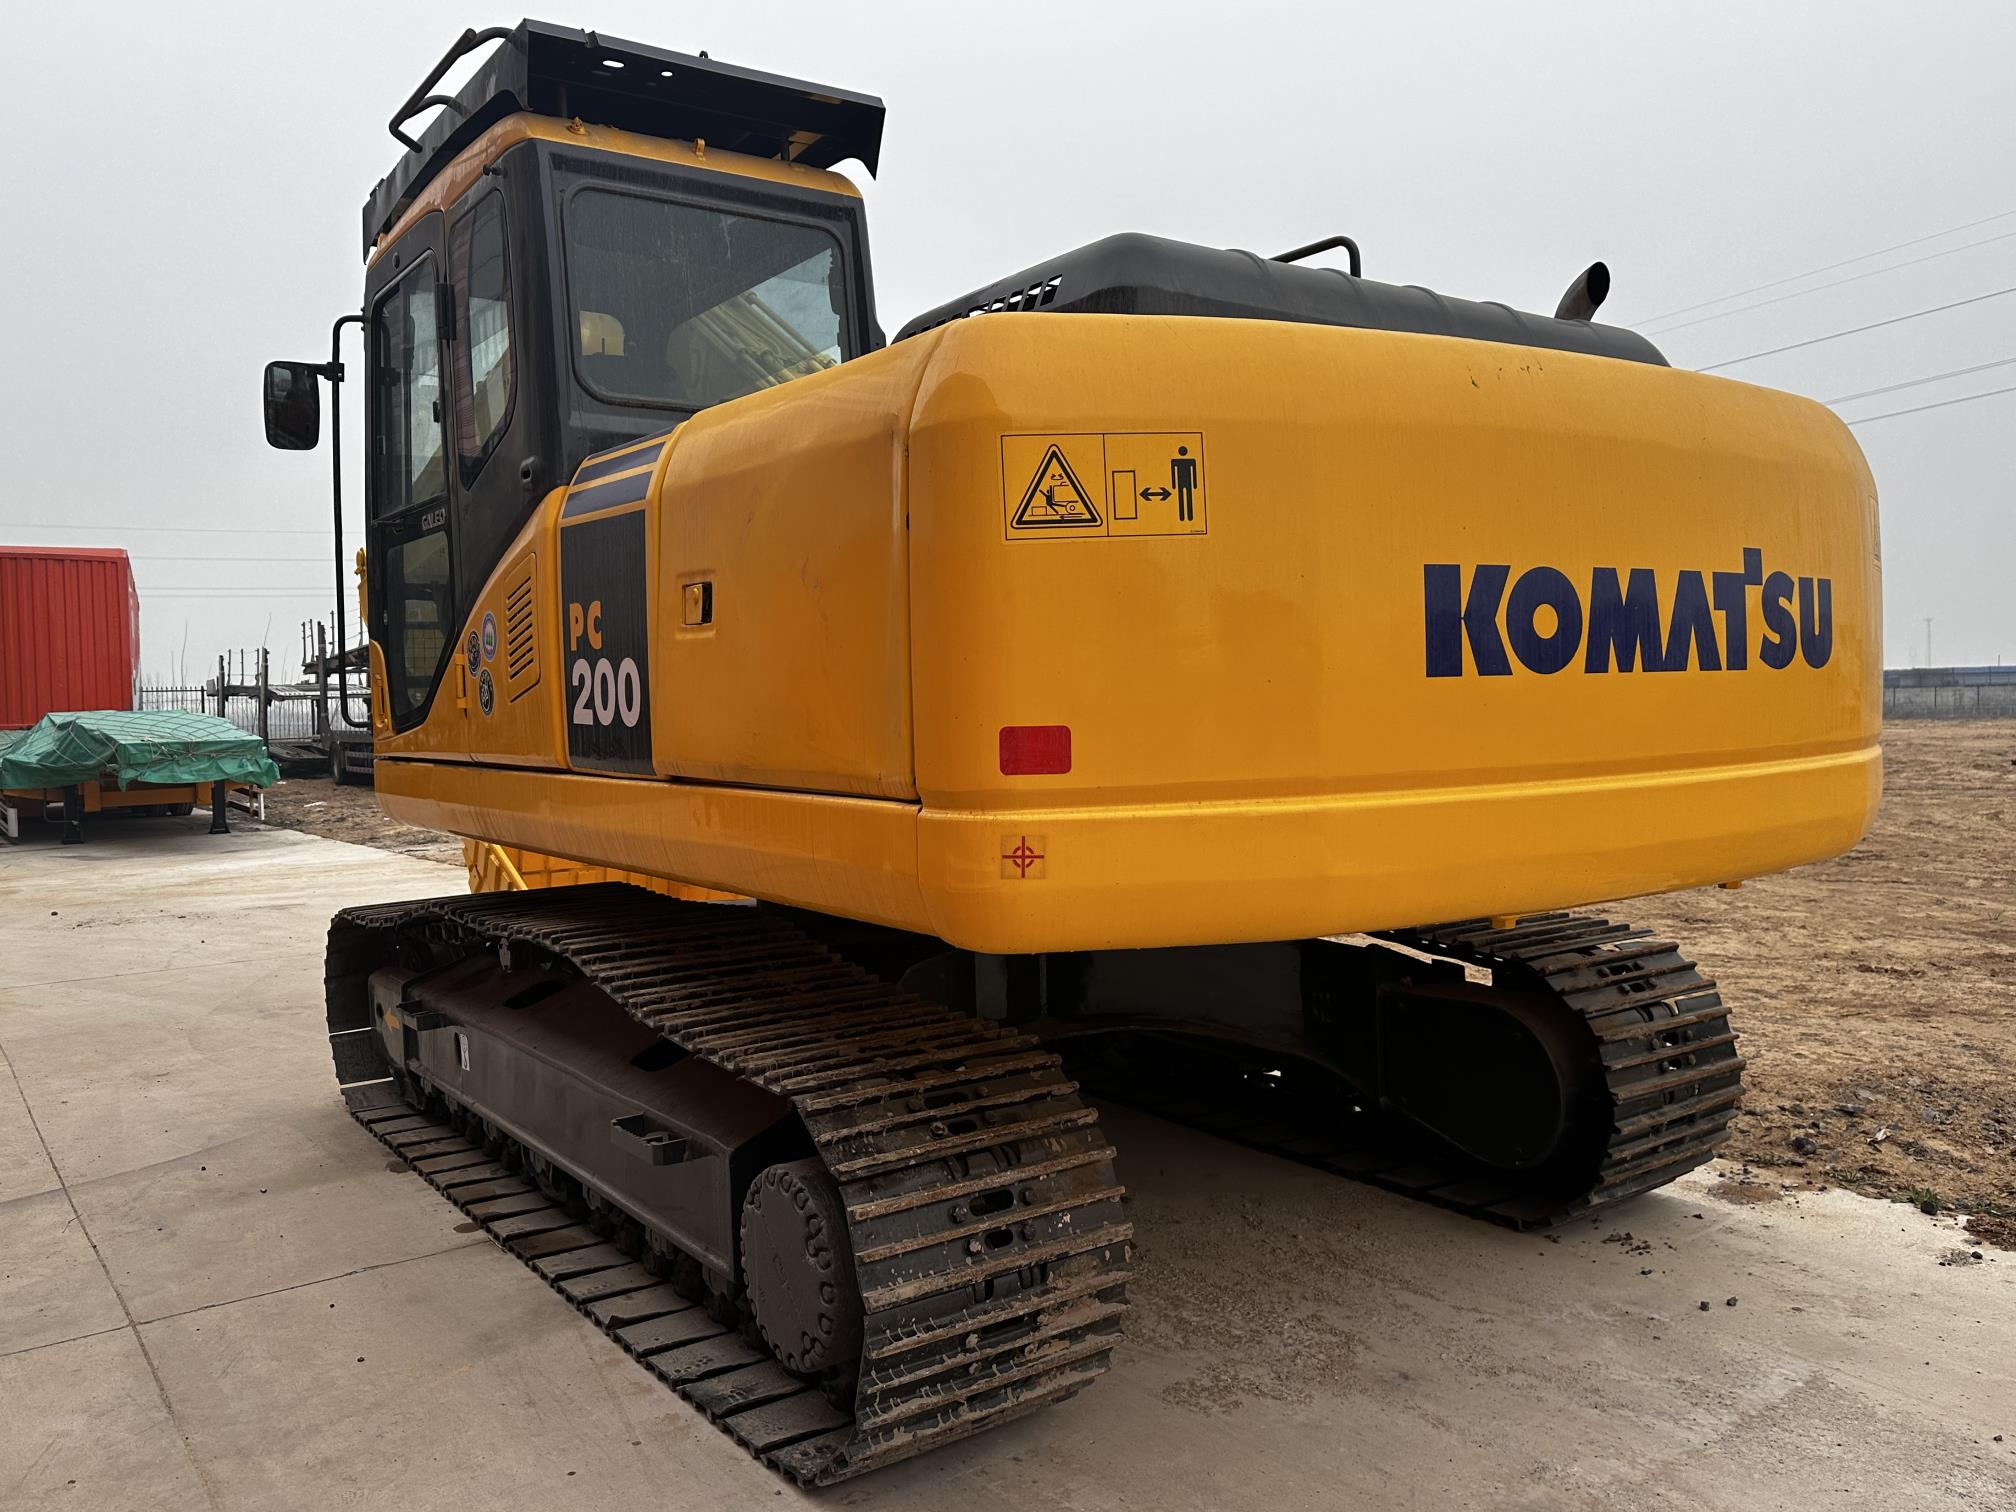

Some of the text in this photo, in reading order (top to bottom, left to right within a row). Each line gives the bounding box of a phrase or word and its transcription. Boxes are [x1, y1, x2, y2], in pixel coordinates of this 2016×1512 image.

[569, 600, 602, 652] PC
[1423, 547, 1833, 678] KOMATSU
[572, 657, 641, 728] 200
